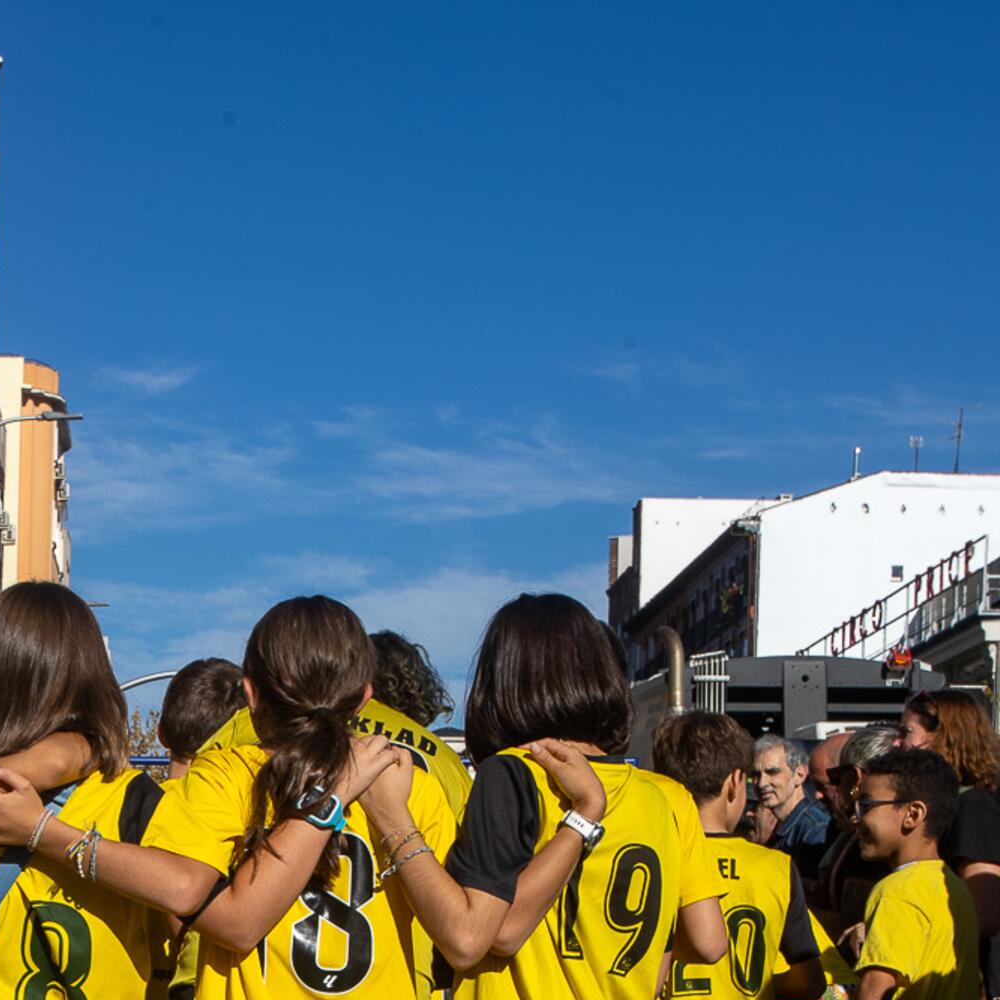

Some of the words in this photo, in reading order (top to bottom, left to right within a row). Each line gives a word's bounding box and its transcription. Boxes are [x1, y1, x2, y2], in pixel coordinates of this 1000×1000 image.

[831, 600, 883, 657] CIRCO
[717, 858, 740, 881] EL
[257, 830, 375, 995] 8
